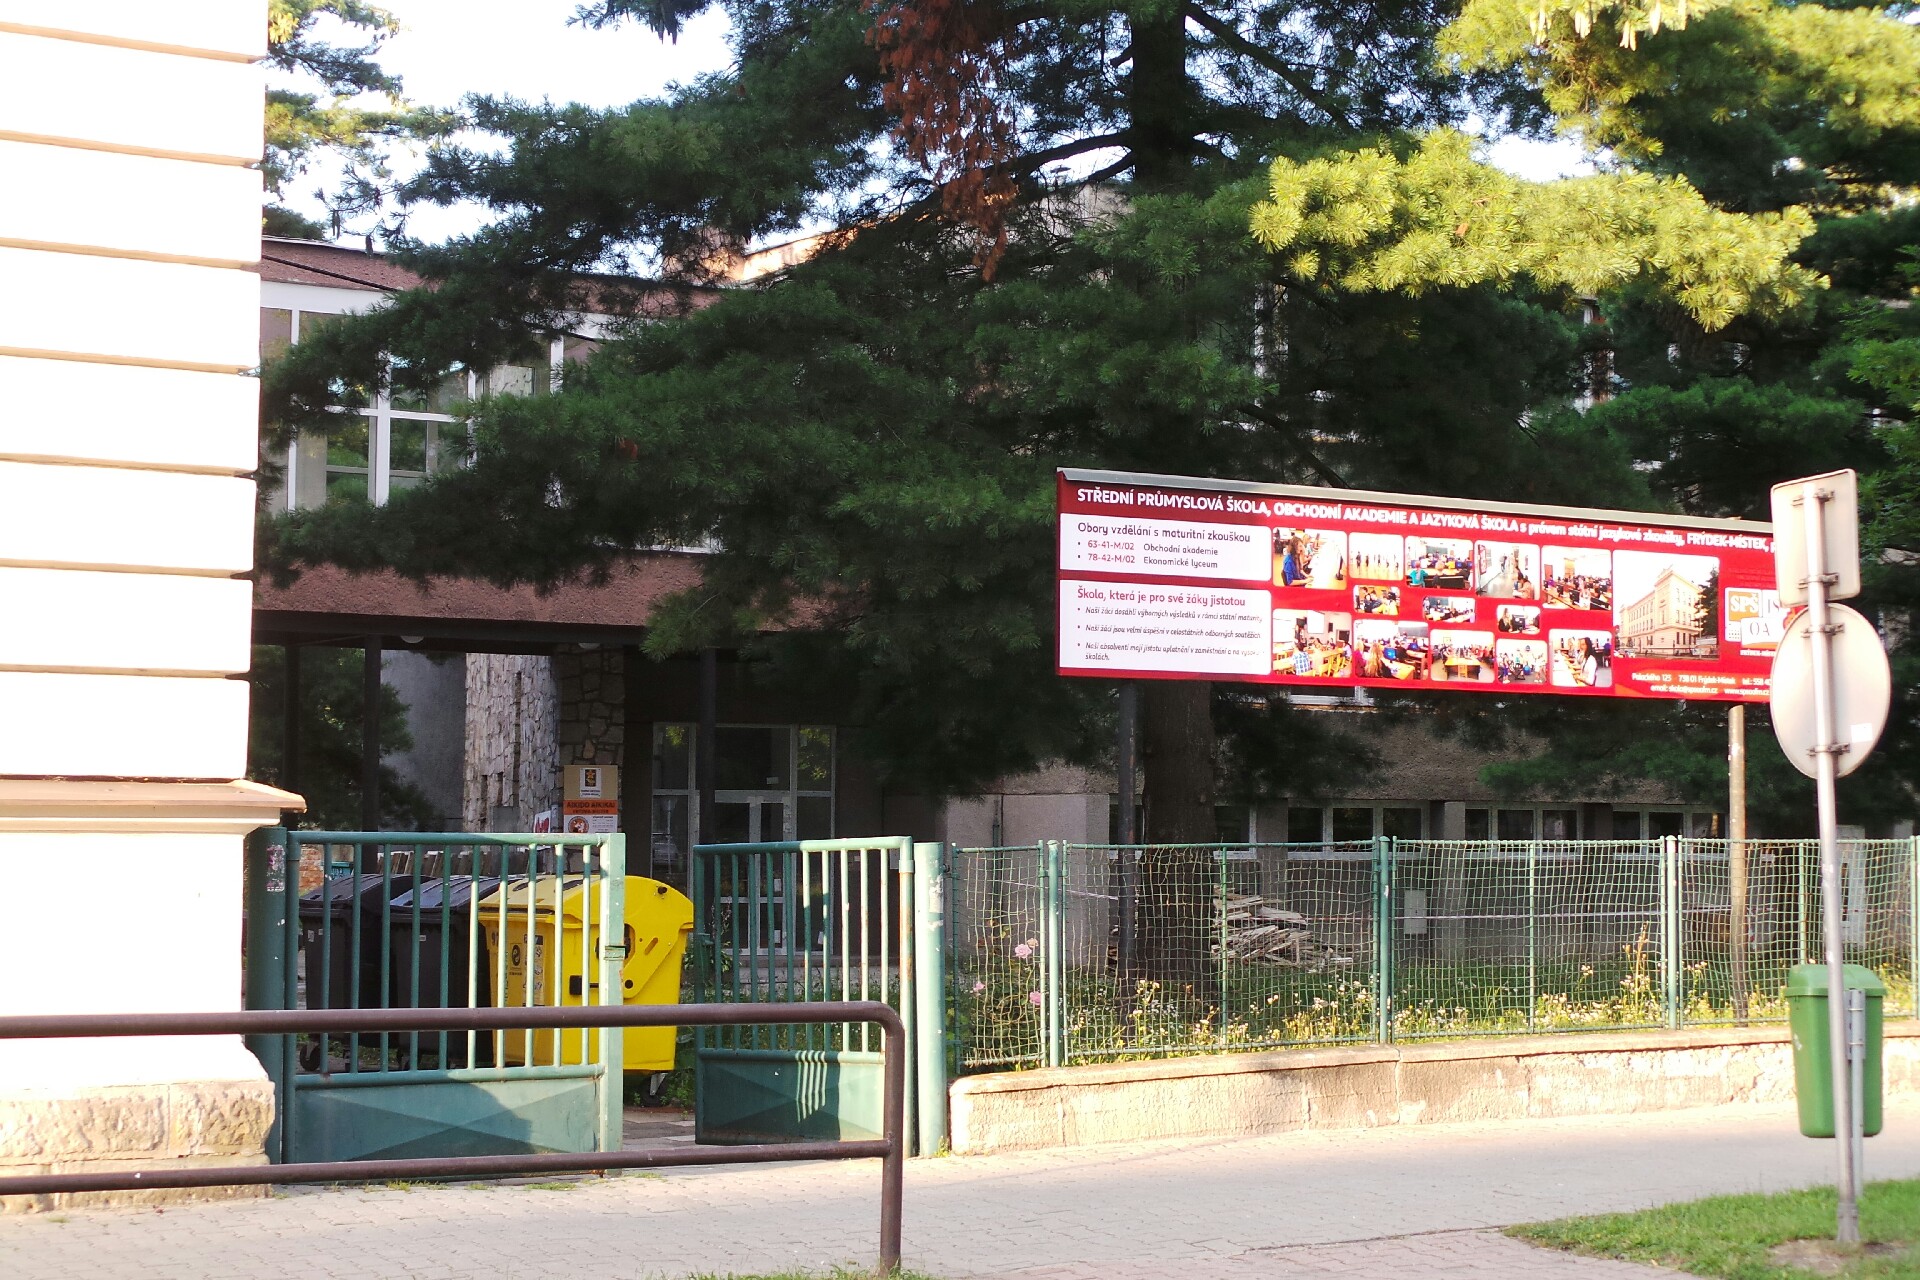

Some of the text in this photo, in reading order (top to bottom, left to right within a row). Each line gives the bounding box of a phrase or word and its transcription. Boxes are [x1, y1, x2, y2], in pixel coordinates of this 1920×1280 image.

[1077, 487, 1134, 505] STŘEDNÍ
[1137, 491, 1223, 511] PRŮMYSLOVÁ
[1227, 496, 1271, 517] ŠKOLA,
[1273, 502, 1342, 520] OBCHODNÍ
[1343, 507, 1407, 524] AKADEMIE
[1409, 511, 1418, 525] A
[1420, 513, 1479, 530] JAZYKOVÁ
[1481, 514, 1519, 532] ŠKOLA
[1520, 523, 1527, 533] s
[1528, 521, 1567, 536] právem
[1568, 522, 1598, 538] státní
[1077, 522, 1251, 543] Obory vzdělání s maturitní zkouškou
[1087, 539, 1219, 556] 63-41-M/02 Obchodní akademie
[1087, 553, 1218, 569] 78-42-M/02 Ekonomické lyceum
[1077, 585, 1246, 608] Škola, která je pro své žáky jistotou
[1085, 606, 1100, 614] Naši
[1085, 624, 1100, 632] Naši
